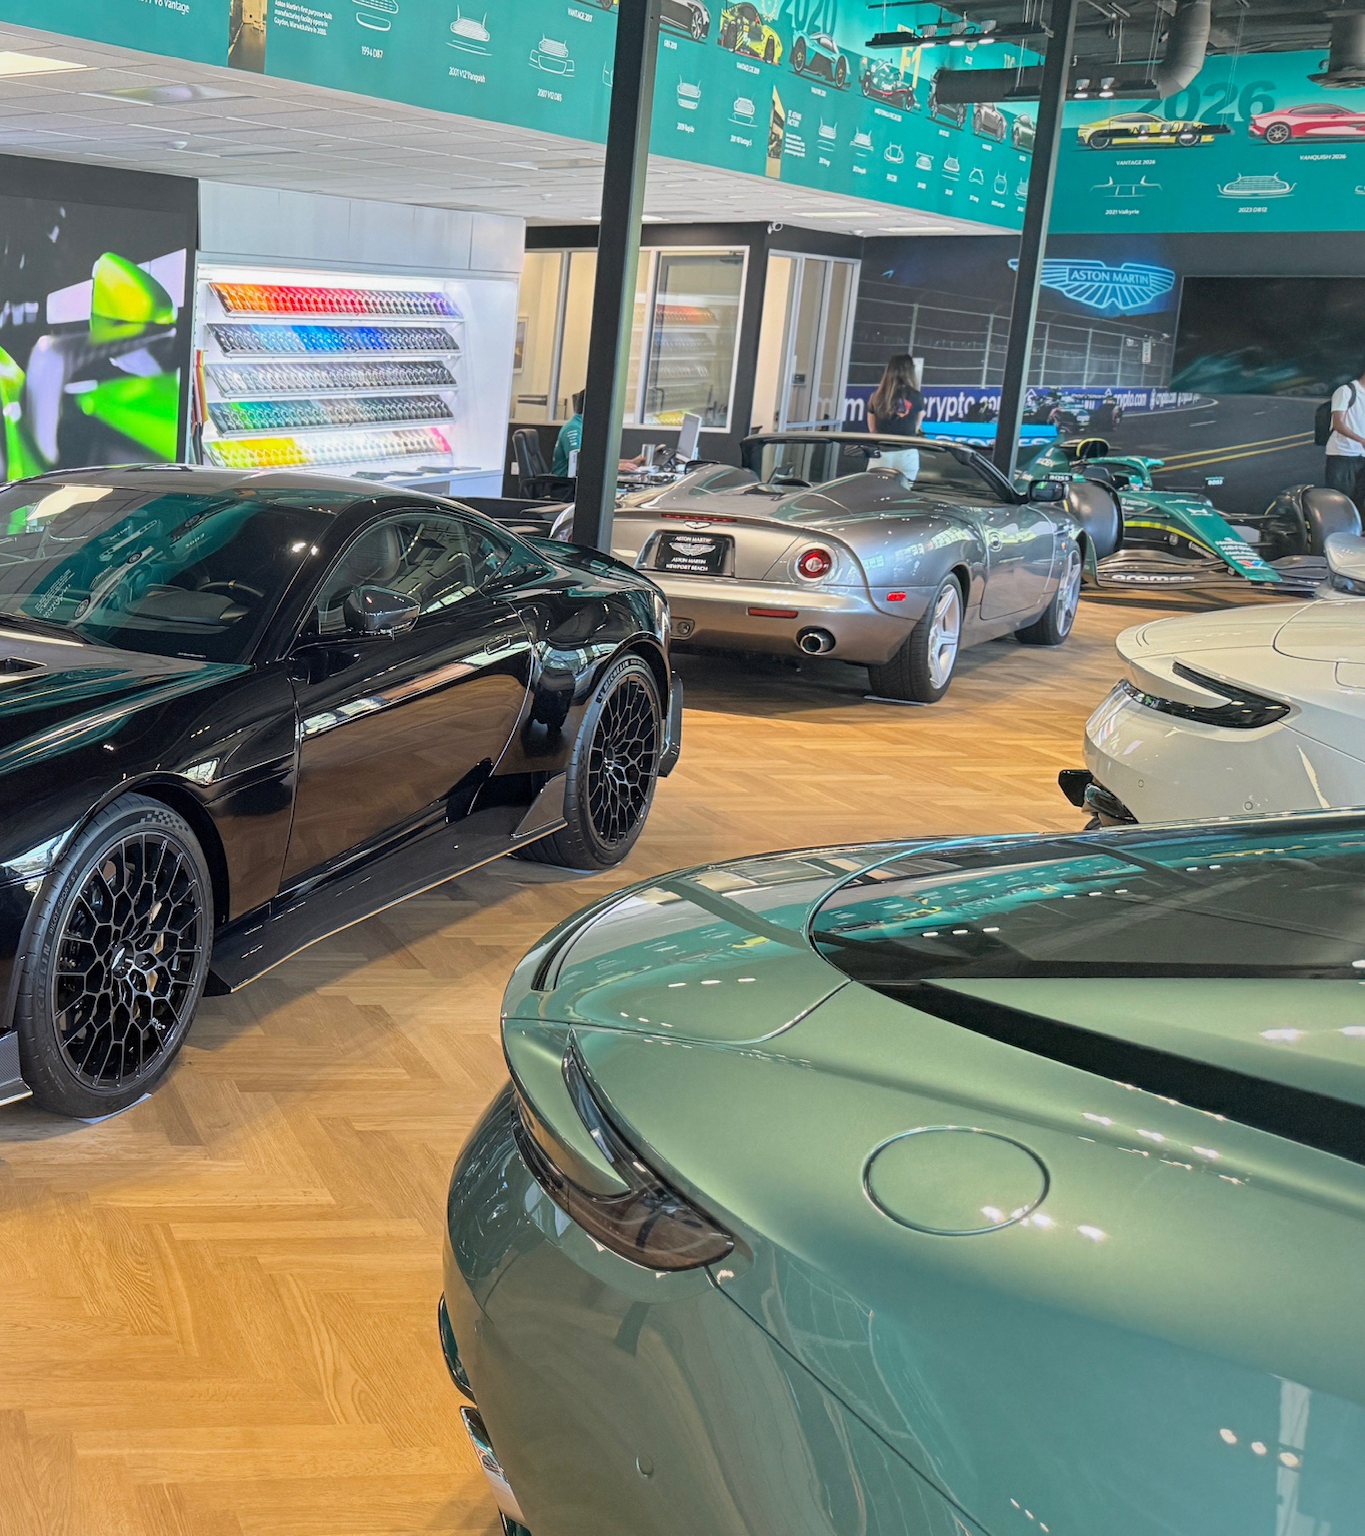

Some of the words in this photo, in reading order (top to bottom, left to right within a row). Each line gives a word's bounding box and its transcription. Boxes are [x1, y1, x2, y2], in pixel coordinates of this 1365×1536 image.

[164, 0, 190, 15] Vantage
[1070, 269, 1111, 282] ASTON
[1112, 271, 1150, 286] MARTIN
[1111, 574, 1196, 583] aramco
[603, 660, 630, 692] MICHELIN
[48, 910, 60, 935] PILOT
[57, 881, 72, 910] SPORT
[38, 944, 51, 1030] ICHELIN
